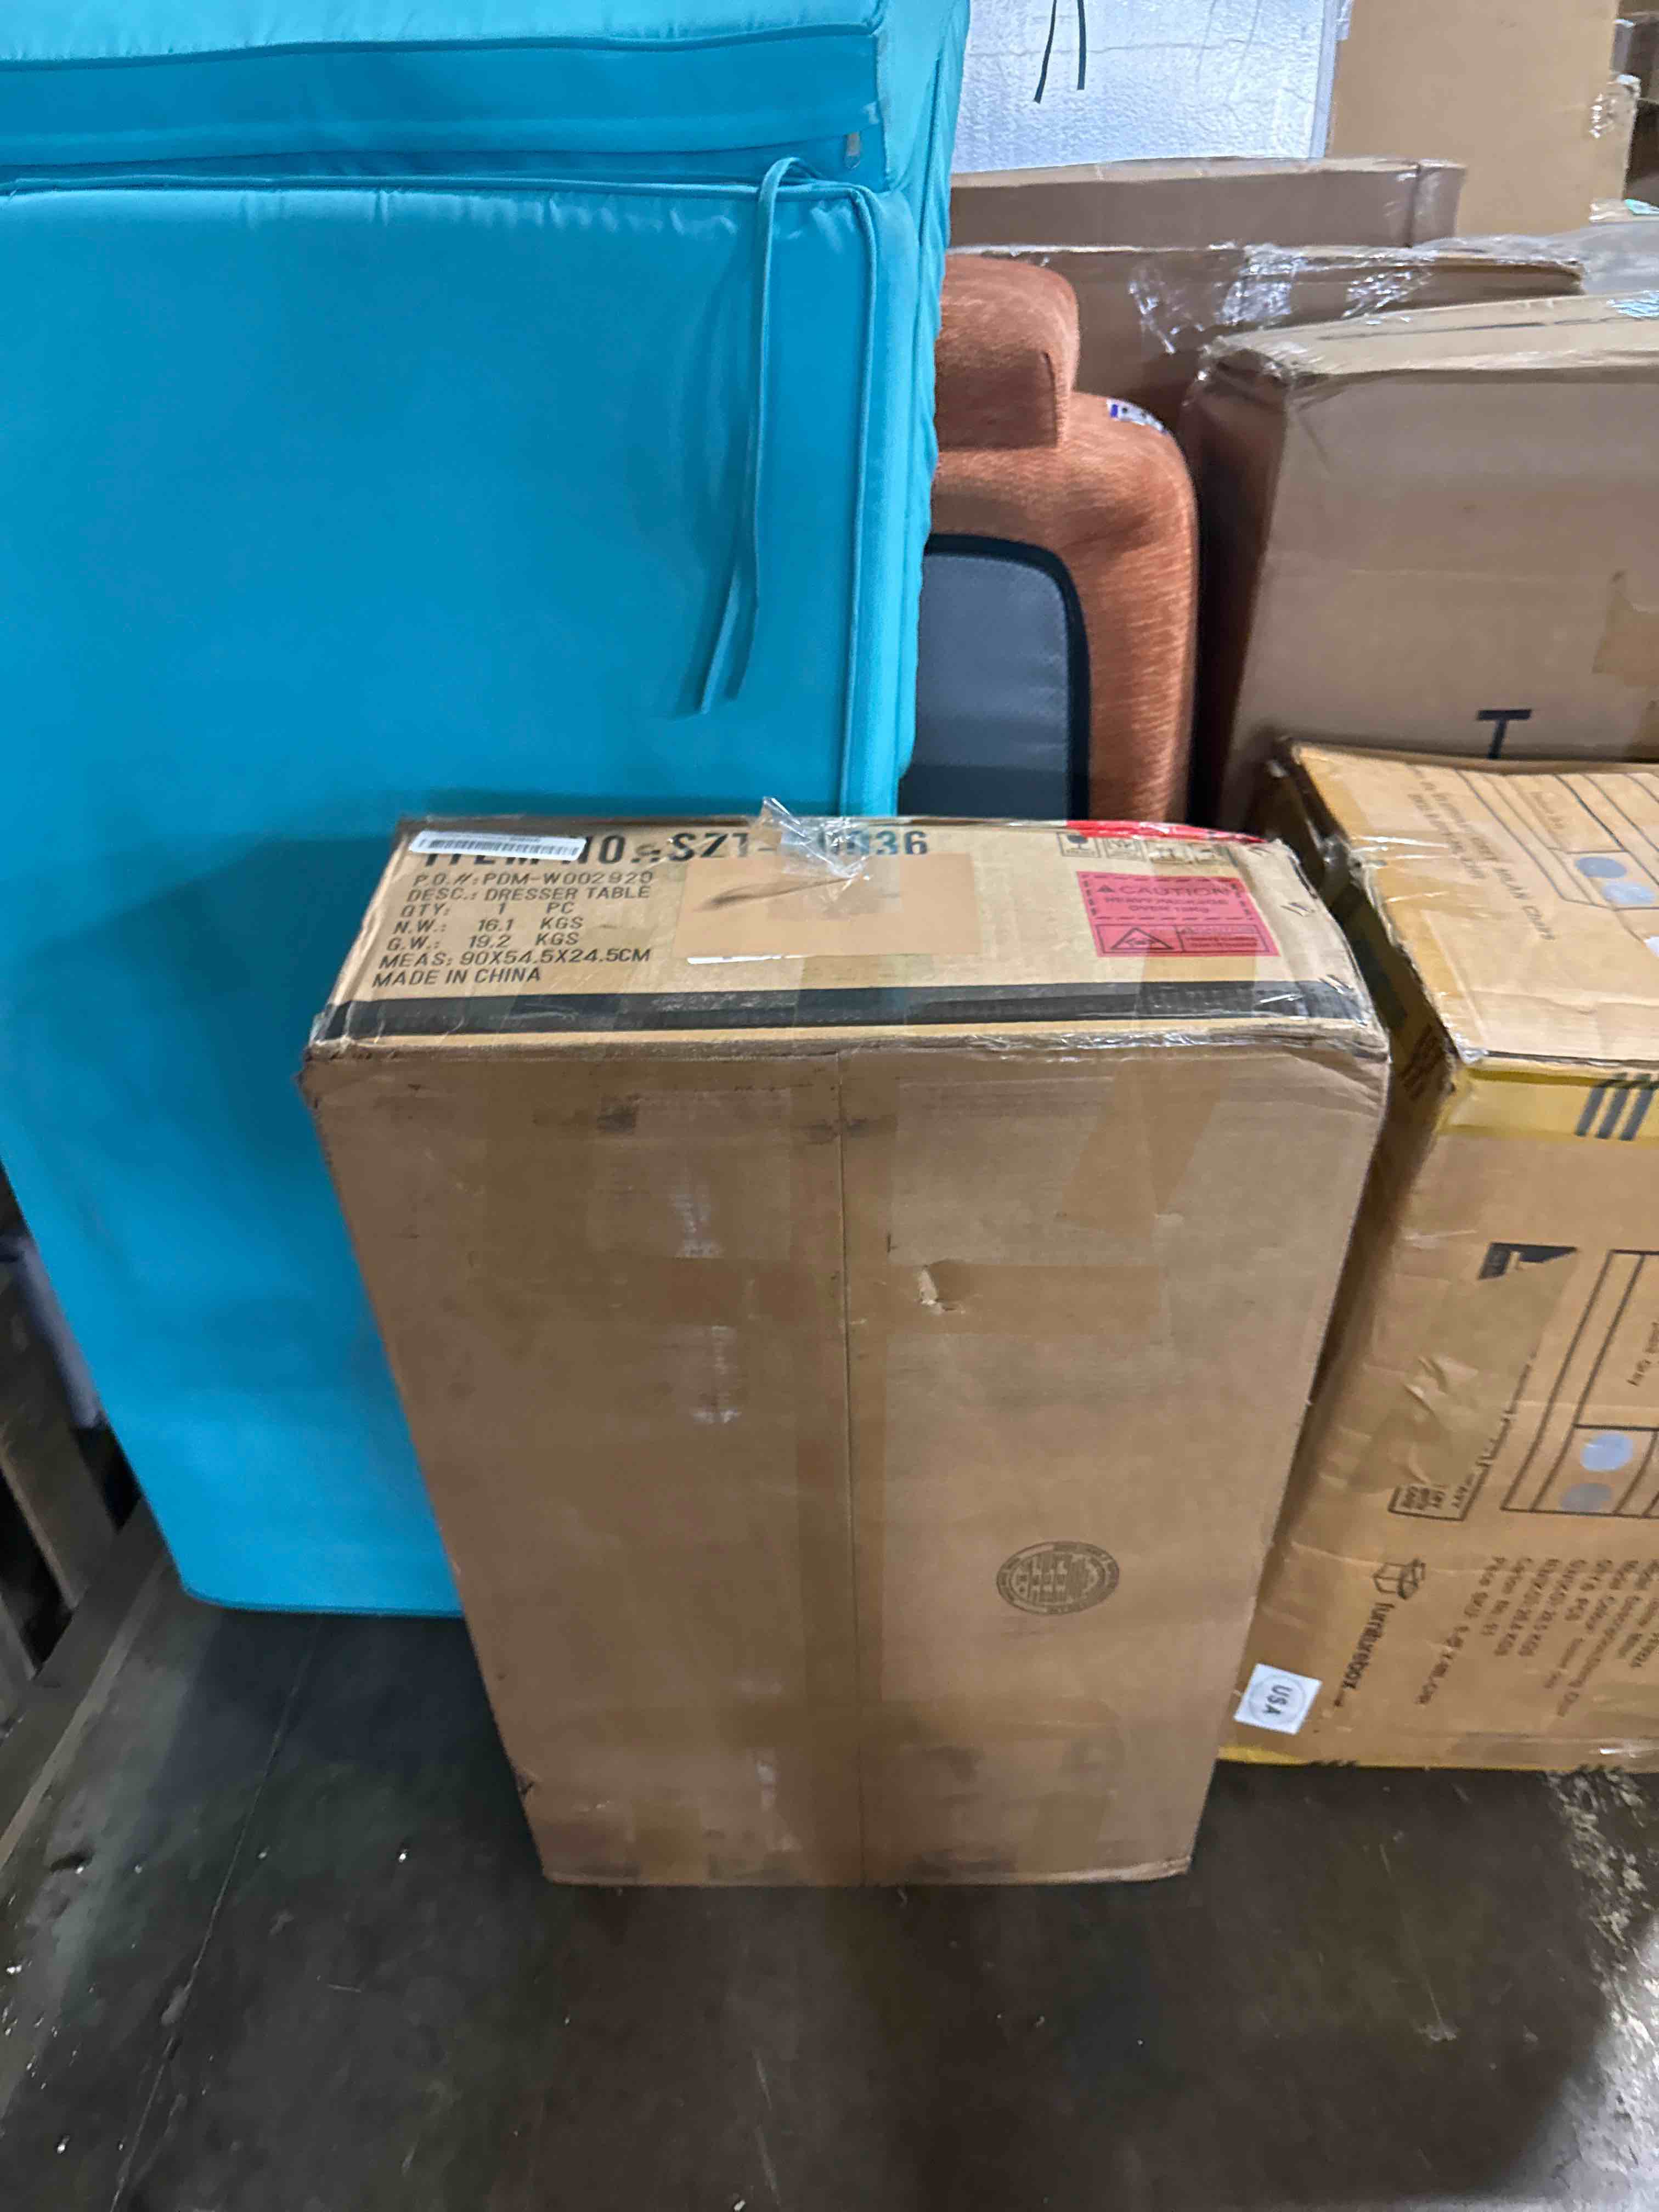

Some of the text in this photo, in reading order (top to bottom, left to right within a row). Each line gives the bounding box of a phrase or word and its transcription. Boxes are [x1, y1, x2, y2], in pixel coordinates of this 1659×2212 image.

[484, 887, 578, 901] DRESSER
[585, 885, 651, 899] TABLE
[498, 902, 506, 915] 1
[546, 901, 574, 914] PC
[478, 918, 515, 932] 16.1
[539, 917, 584, 930] KGS
[469, 934, 512, 949] 19.2
[534, 932, 579, 946] KGS
[373, 966, 541, 988] MADE IN CHINA
[1262, 1684, 1293, 1716] USA
